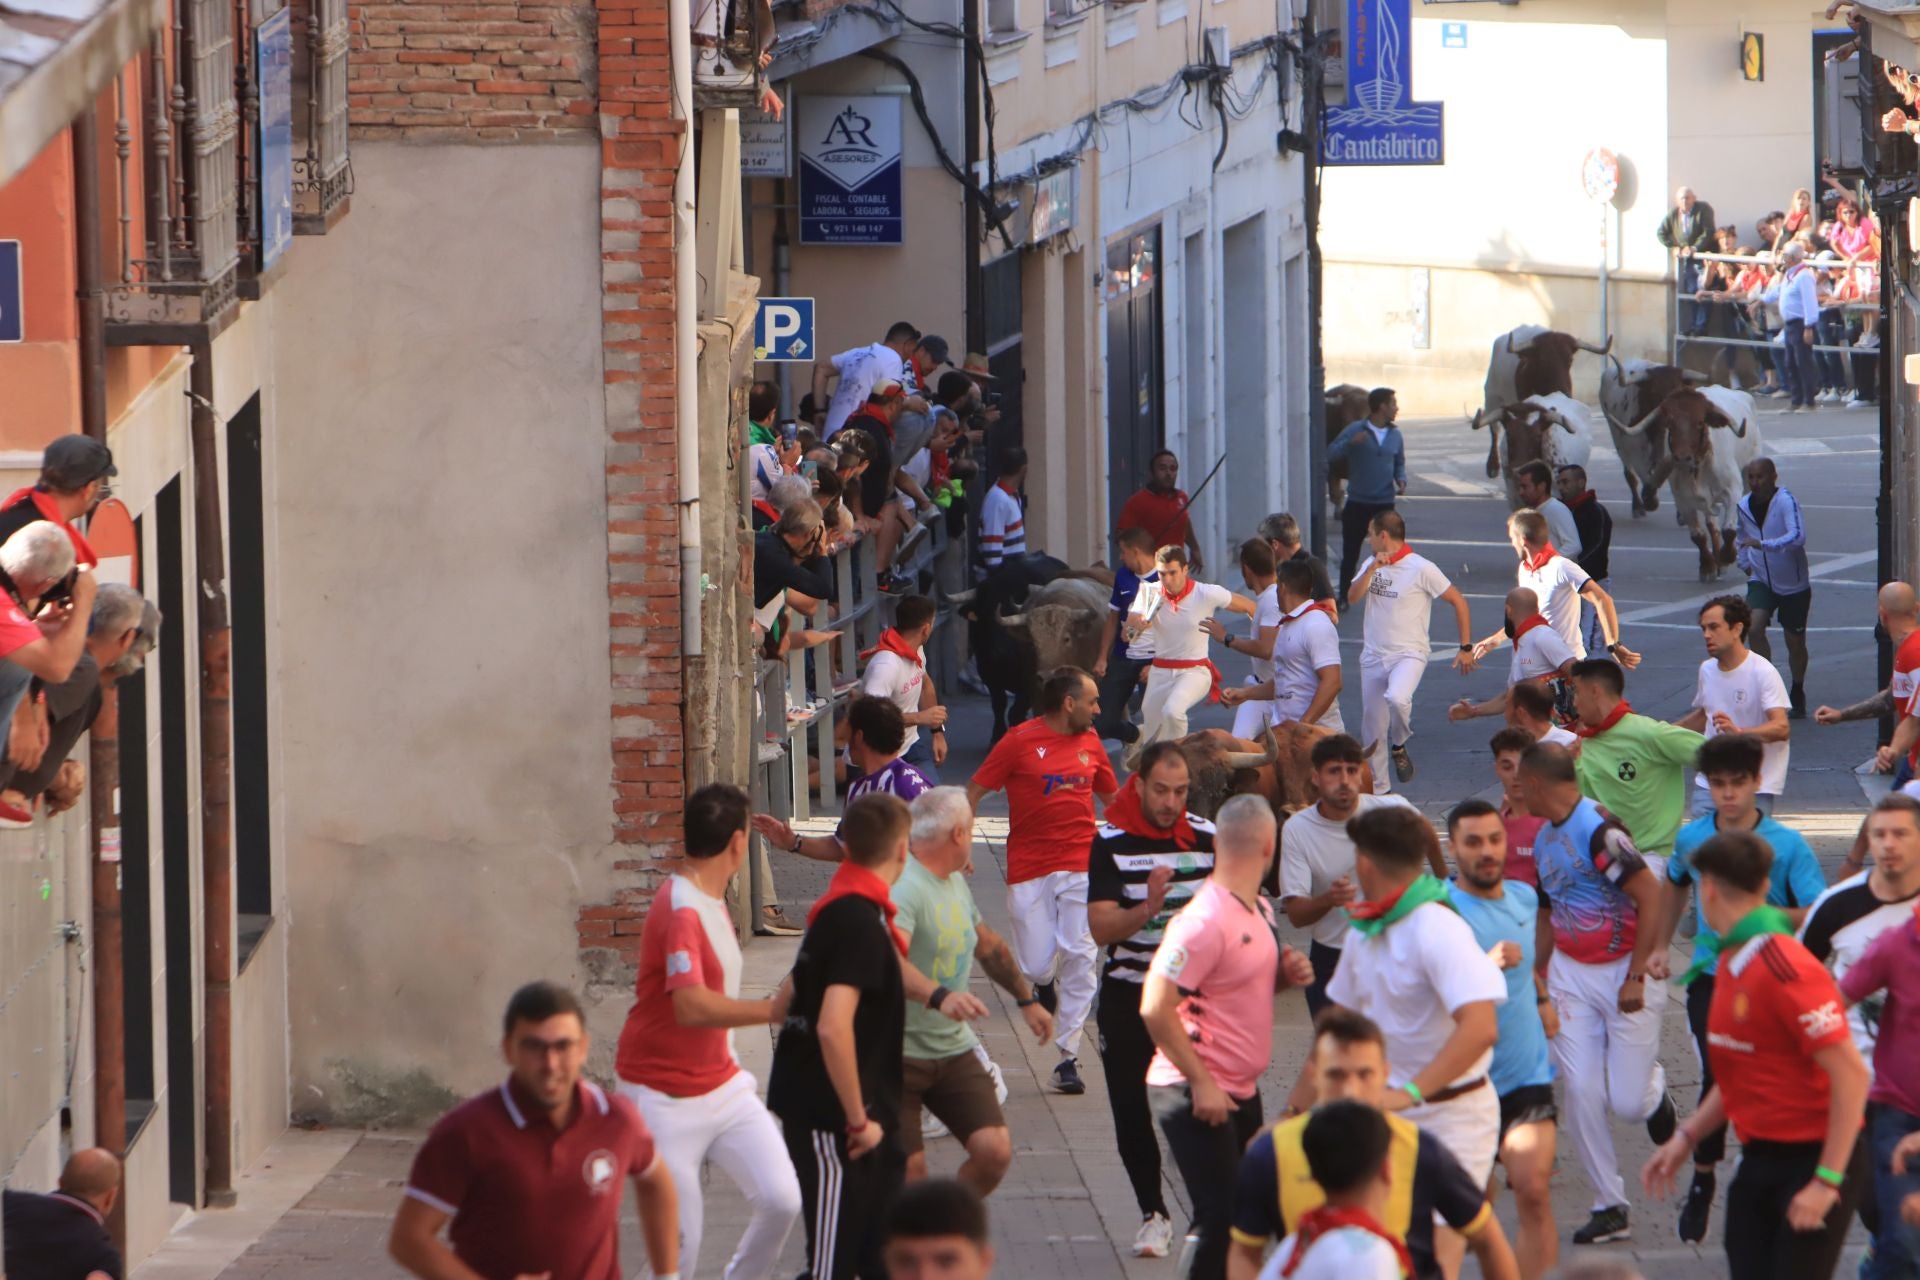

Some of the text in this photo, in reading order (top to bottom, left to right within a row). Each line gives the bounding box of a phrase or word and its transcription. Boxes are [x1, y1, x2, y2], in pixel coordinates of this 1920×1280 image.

[821, 113, 878, 148] AR
[1324, 132, 1438, 160] Cantábrico
[752, 158, 767, 166] 147
[823, 154, 877, 164] ASESORES
[815, 194, 840, 204] FISCAL
[847, 194, 888, 204] CONTABLE
[812, 206, 847, 216] LABORAL
[854, 206, 891, 216] SEGUROS
[834, 224, 884, 233] 921 140 147
[764, 305, 801, 353] P
[1041, 774, 1066, 796] 75
